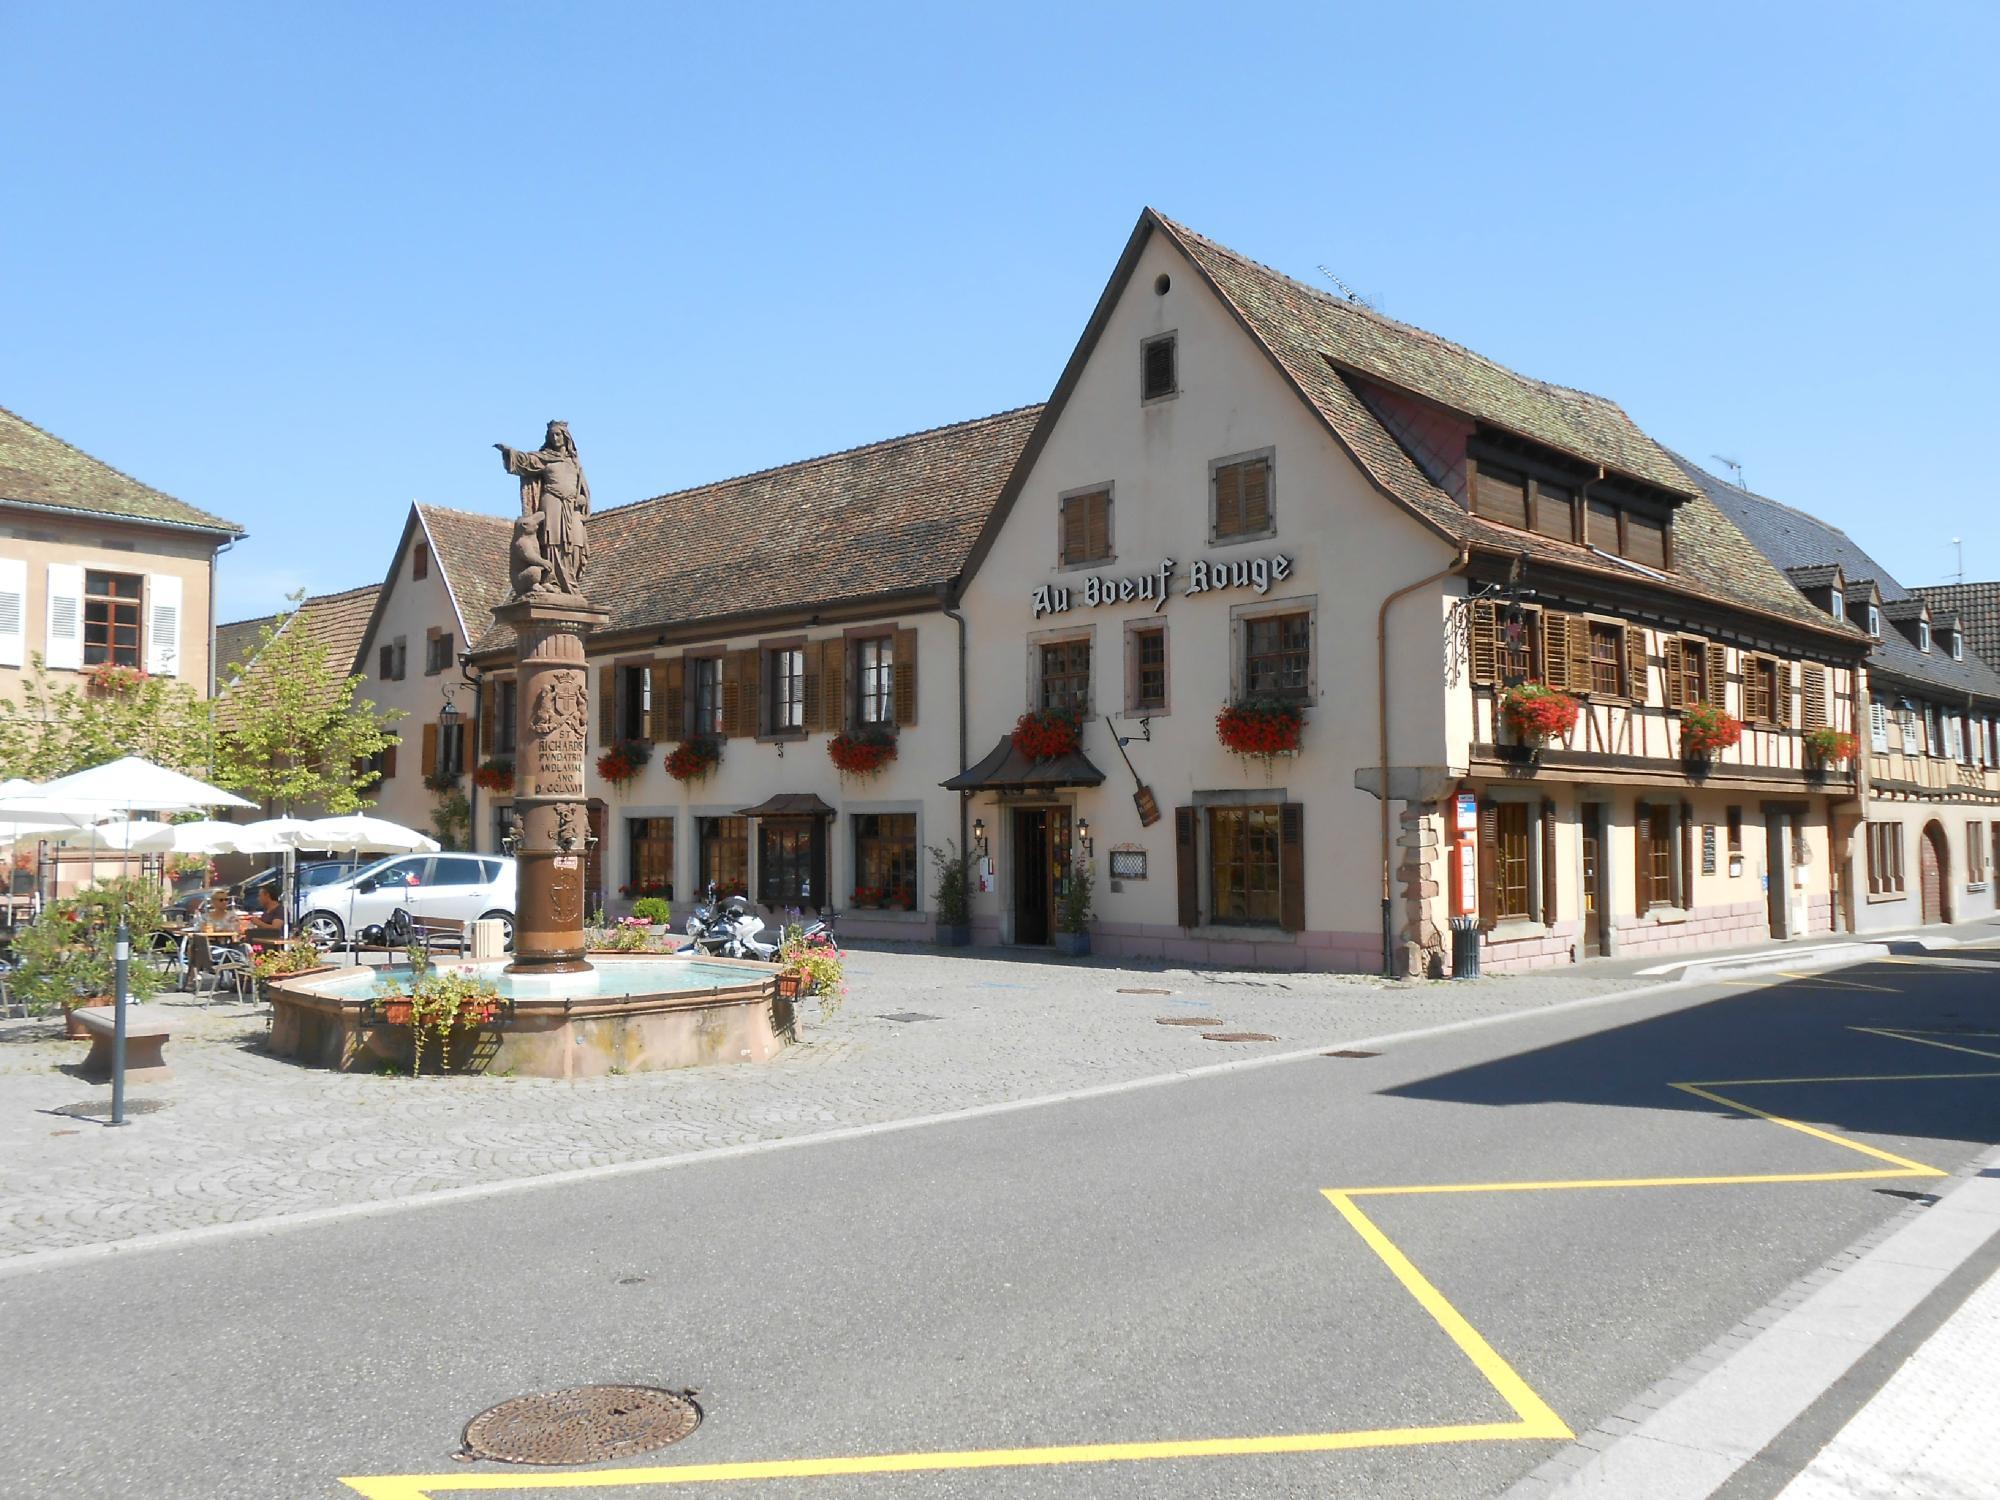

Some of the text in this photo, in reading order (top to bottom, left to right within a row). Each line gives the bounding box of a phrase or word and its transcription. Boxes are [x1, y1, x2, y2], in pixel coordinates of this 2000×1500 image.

[1032, 554, 1291, 619] Au Boeuf Rouge
